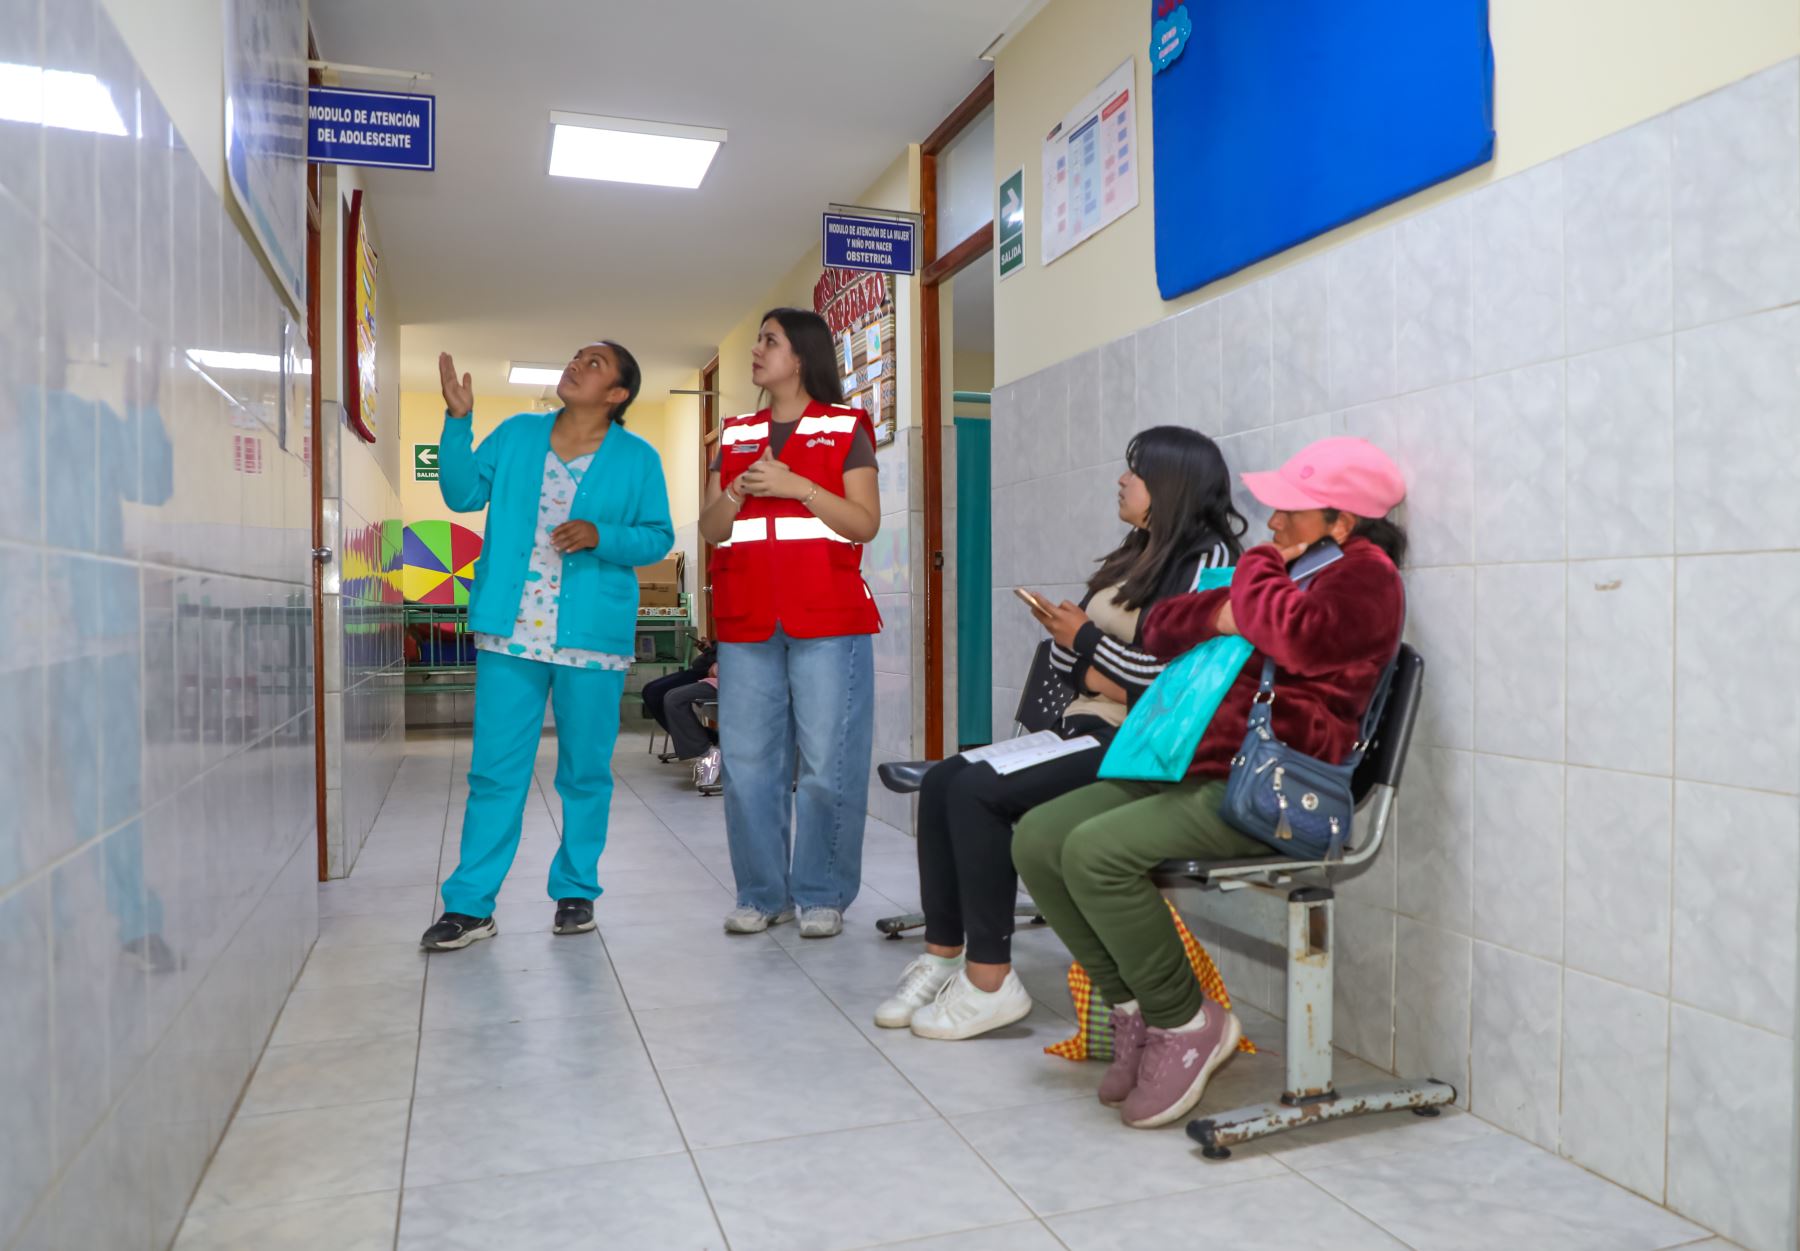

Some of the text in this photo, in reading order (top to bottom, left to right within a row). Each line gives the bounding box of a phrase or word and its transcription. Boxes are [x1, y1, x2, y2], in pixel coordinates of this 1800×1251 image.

[309, 105, 420, 128] MODULO DE ATENCIÓN
[318, 128, 411, 148] DEL ADOLESCENTE
[828, 224, 909, 241] MODULO DE ATENCIÓN DE LA MUJER
[846, 238, 850, 248] Y
[865, 240, 875, 250] POR
[876, 241, 892, 252] NACER
[846, 251, 892, 265] OBSTETRICIA
[1001, 243, 1021, 266] SALIDA
